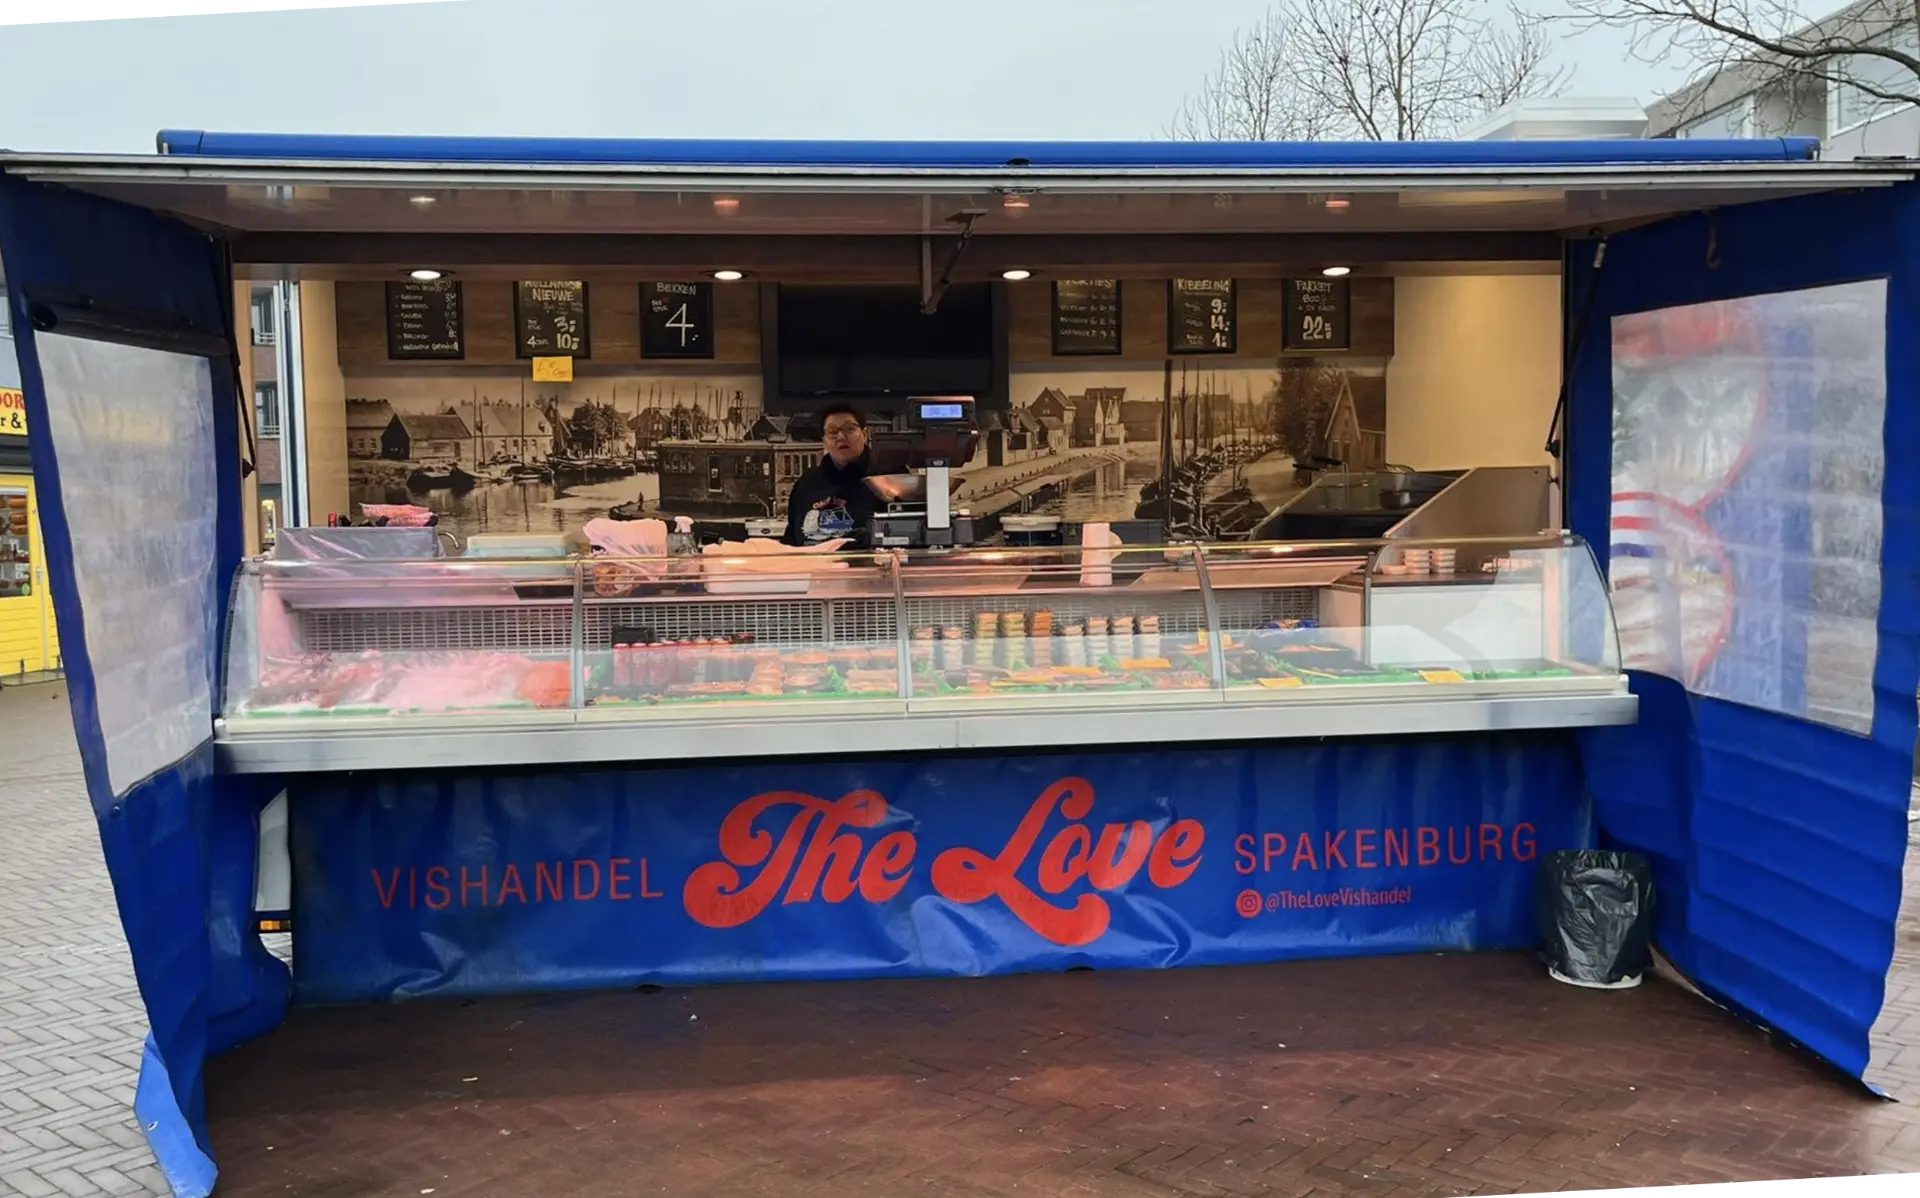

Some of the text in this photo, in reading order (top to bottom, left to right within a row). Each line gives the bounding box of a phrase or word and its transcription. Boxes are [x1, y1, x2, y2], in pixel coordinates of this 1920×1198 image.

[532, 288, 575, 302] NIEUWE
[656, 282, 697, 295] BEKKEN
[373, 776, 1537, 945] VISHANDEL The Love SPAKENBURG
[1266, 886, 1412, 913] @TheLoveVishandel
